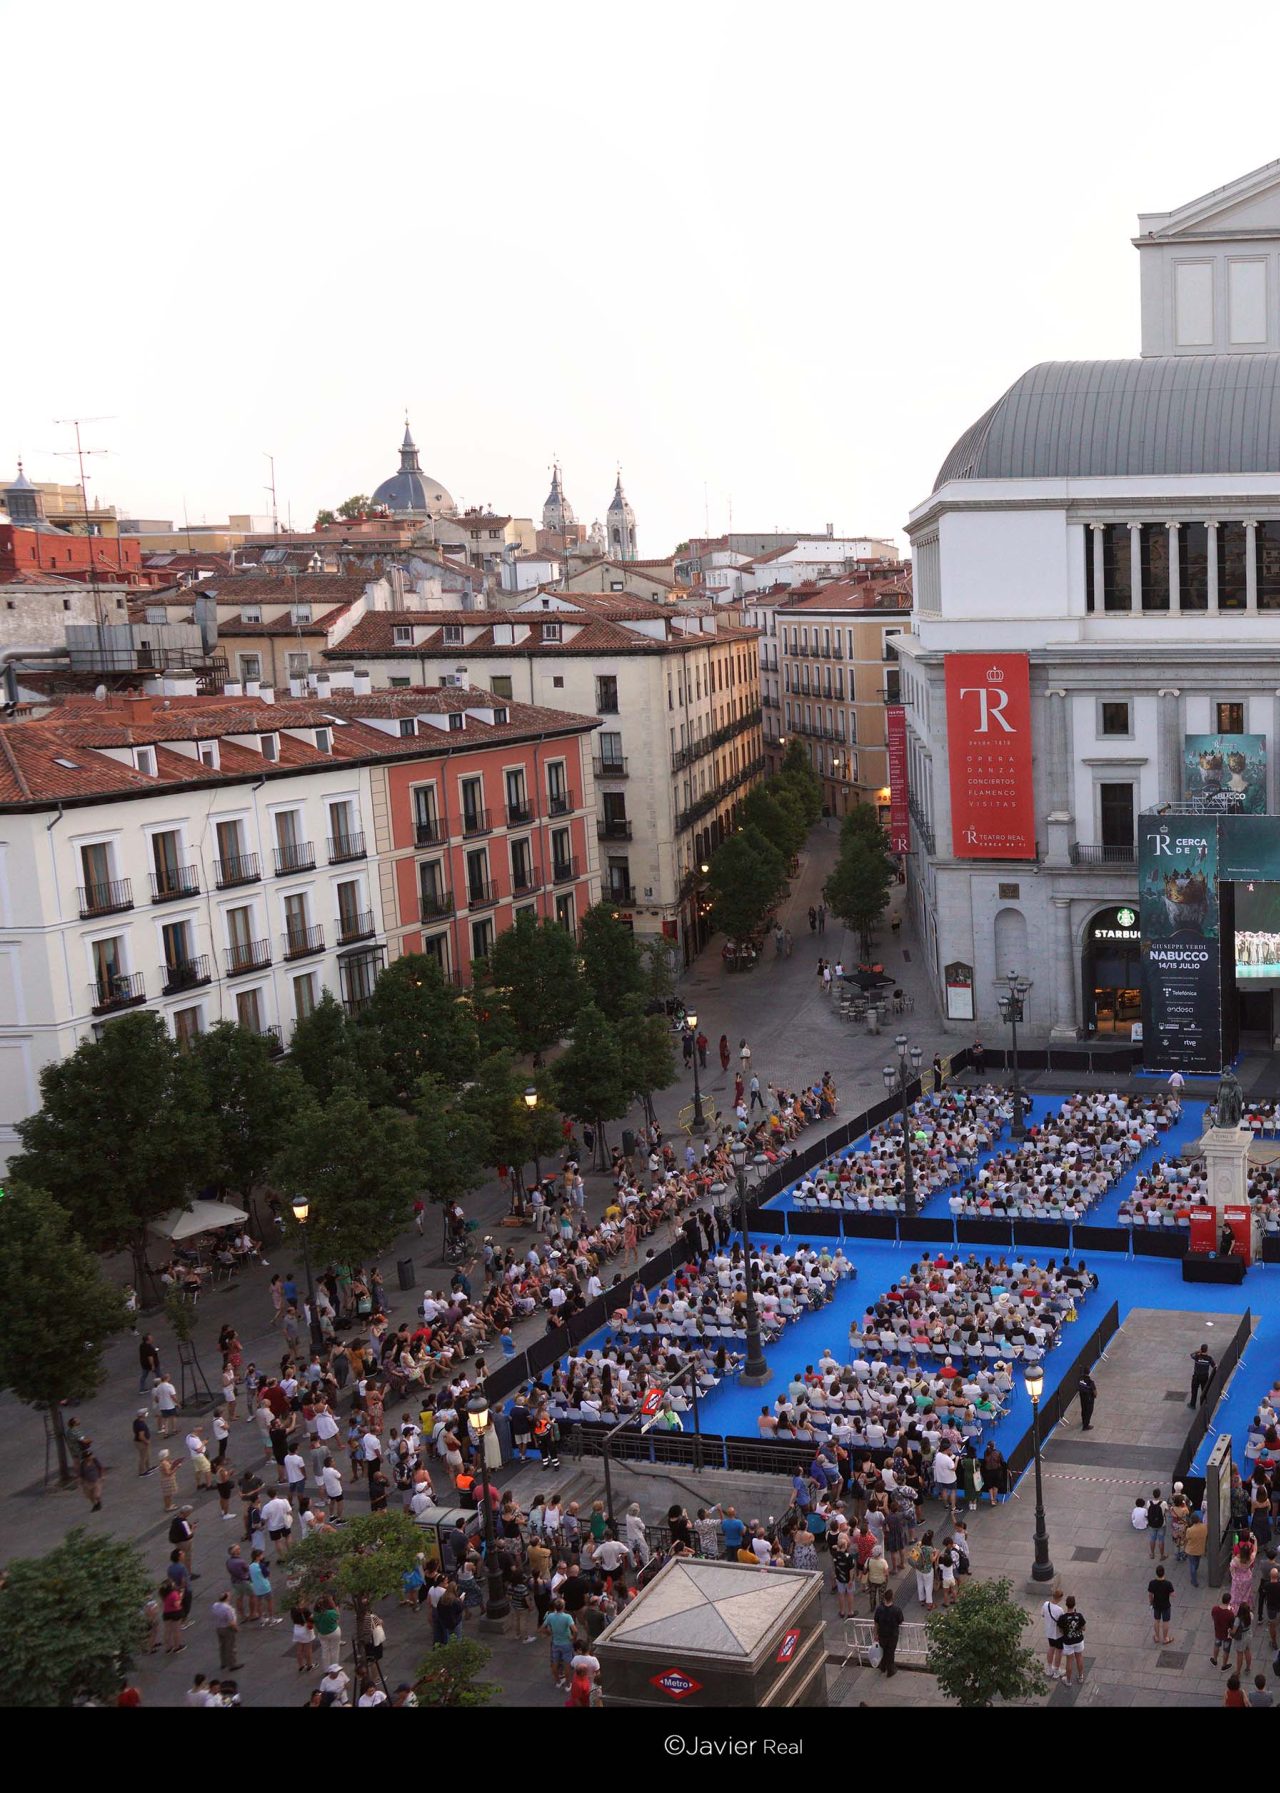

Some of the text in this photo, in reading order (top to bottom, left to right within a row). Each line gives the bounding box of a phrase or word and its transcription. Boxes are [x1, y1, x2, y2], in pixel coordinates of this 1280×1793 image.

[960, 688, 1017, 733] TR
[1147, 835, 1173, 855] TR
[1150, 951, 1208, 961] NABUCCO
[664, 1678, 688, 1688] Metro
